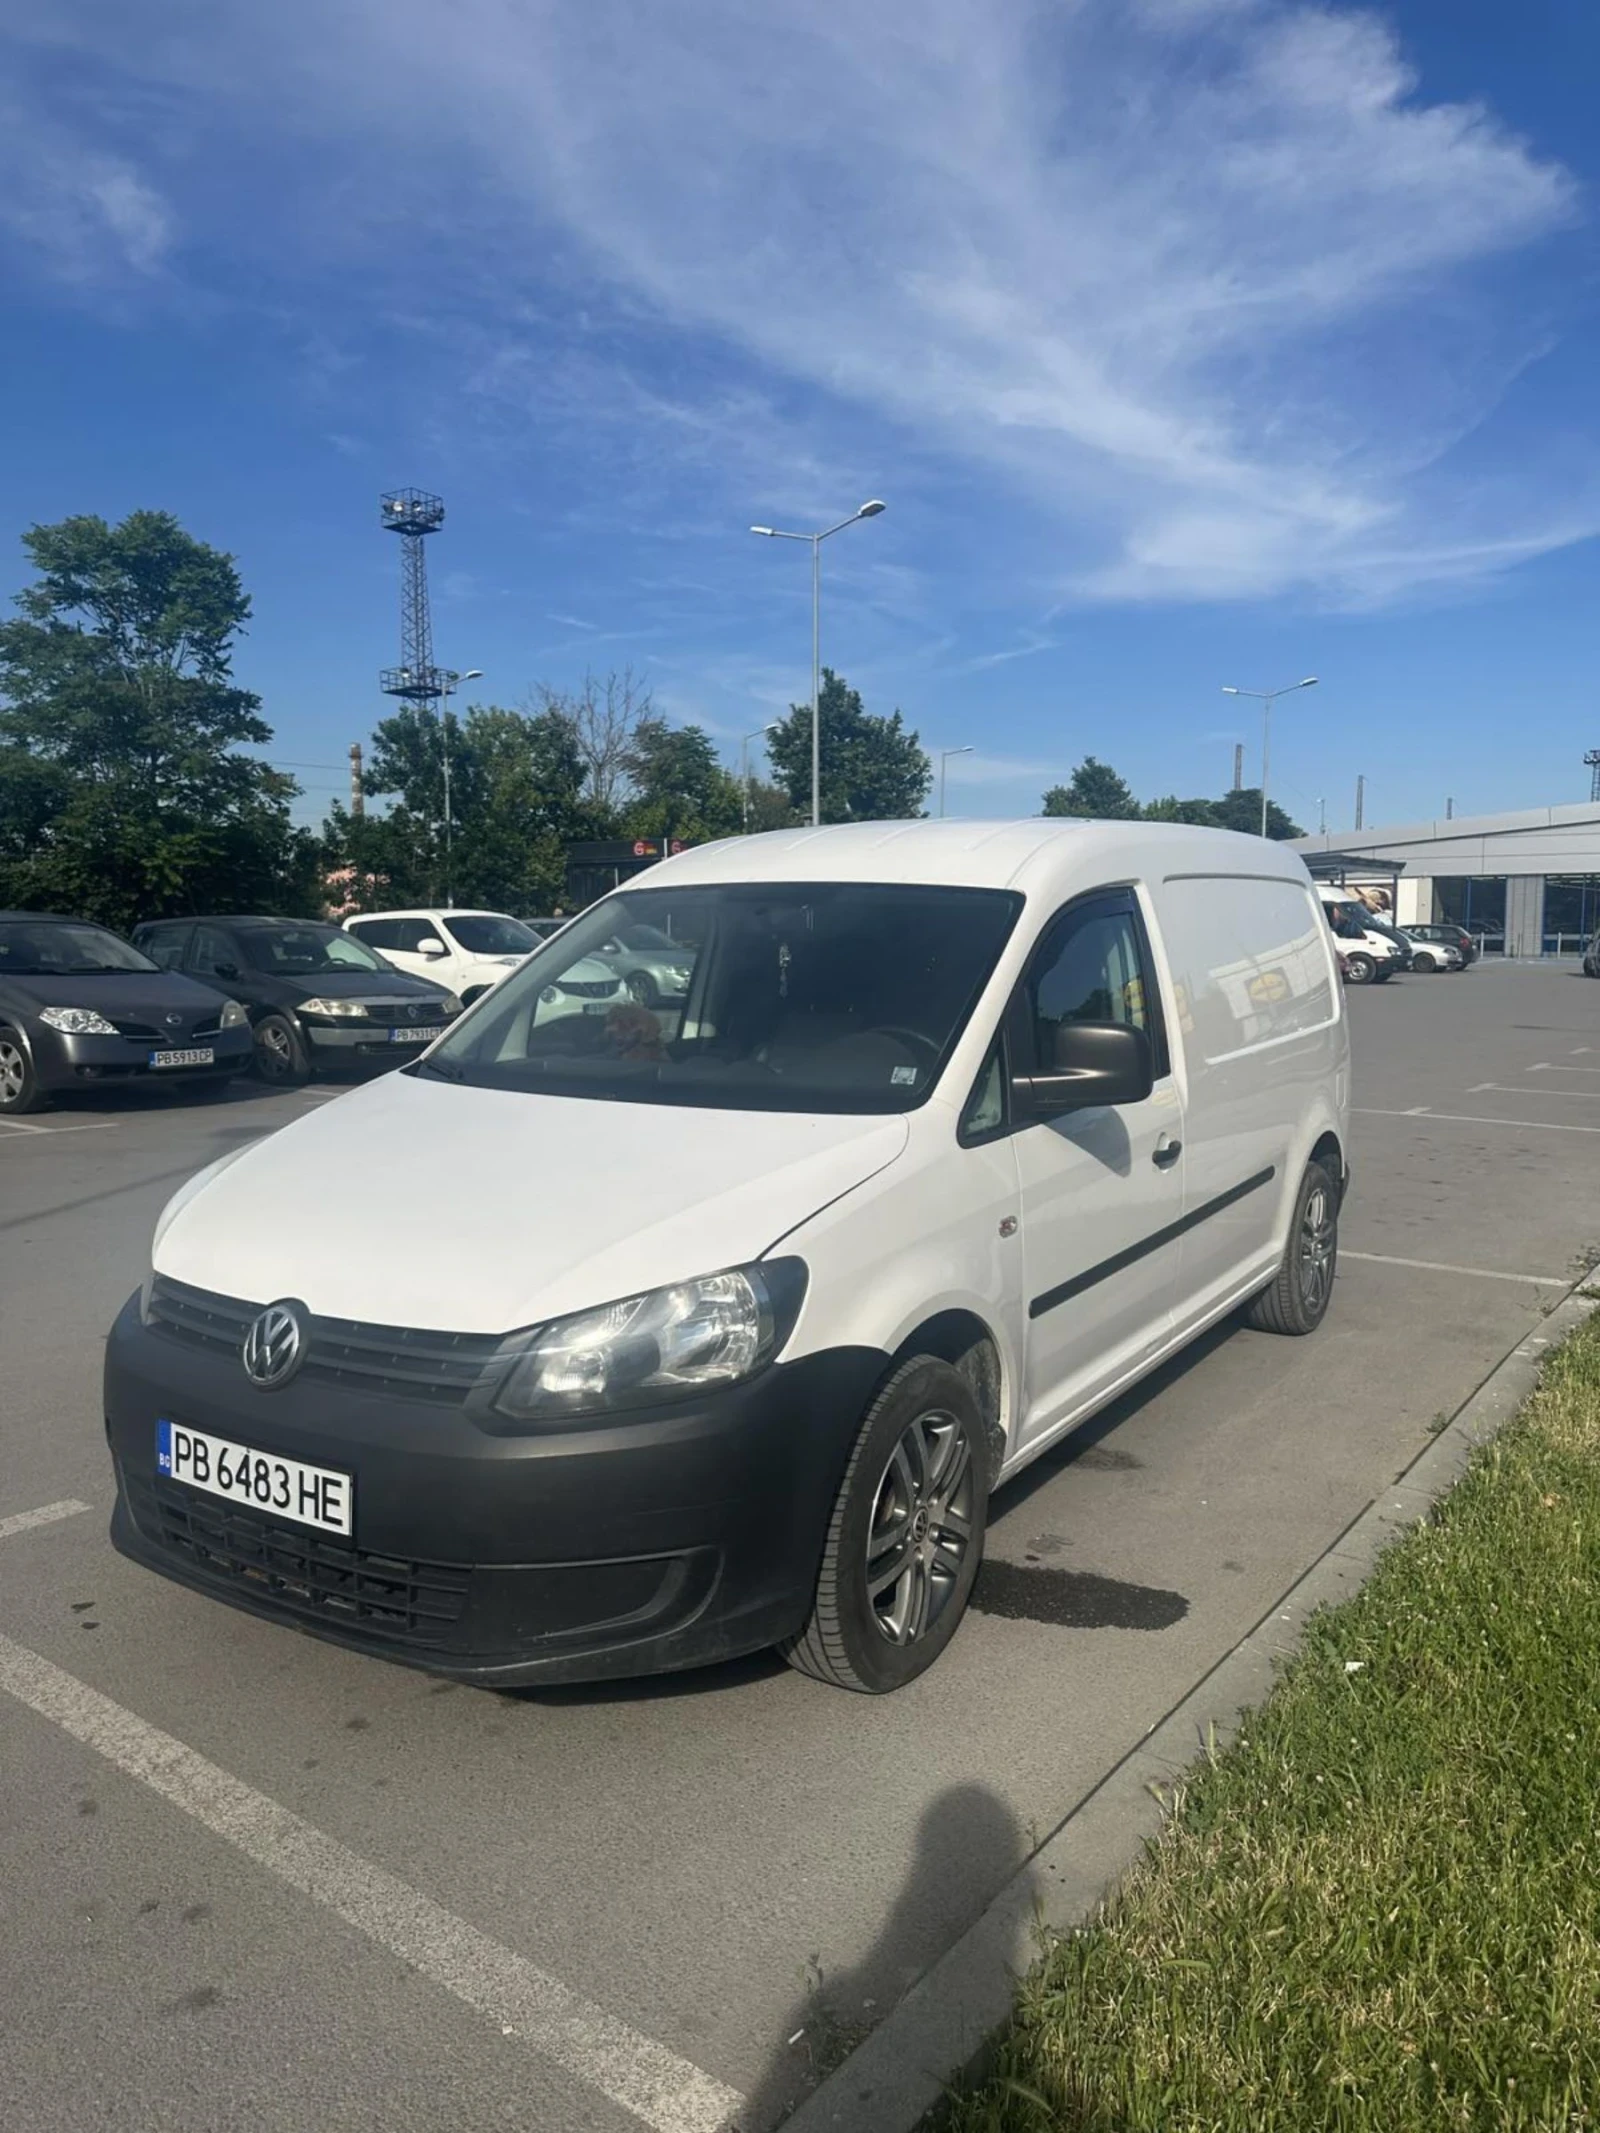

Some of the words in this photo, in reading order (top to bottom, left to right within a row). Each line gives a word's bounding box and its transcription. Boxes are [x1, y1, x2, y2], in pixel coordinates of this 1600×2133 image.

[157, 1052, 171, 1064] PB
[173, 1051, 197, 1063] 5913
[159, 1452, 171, 1468] BG
[175, 1431, 210, 1482] PB
[217, 1447, 290, 1509] 6483
[299, 1470, 343, 1527] HE
